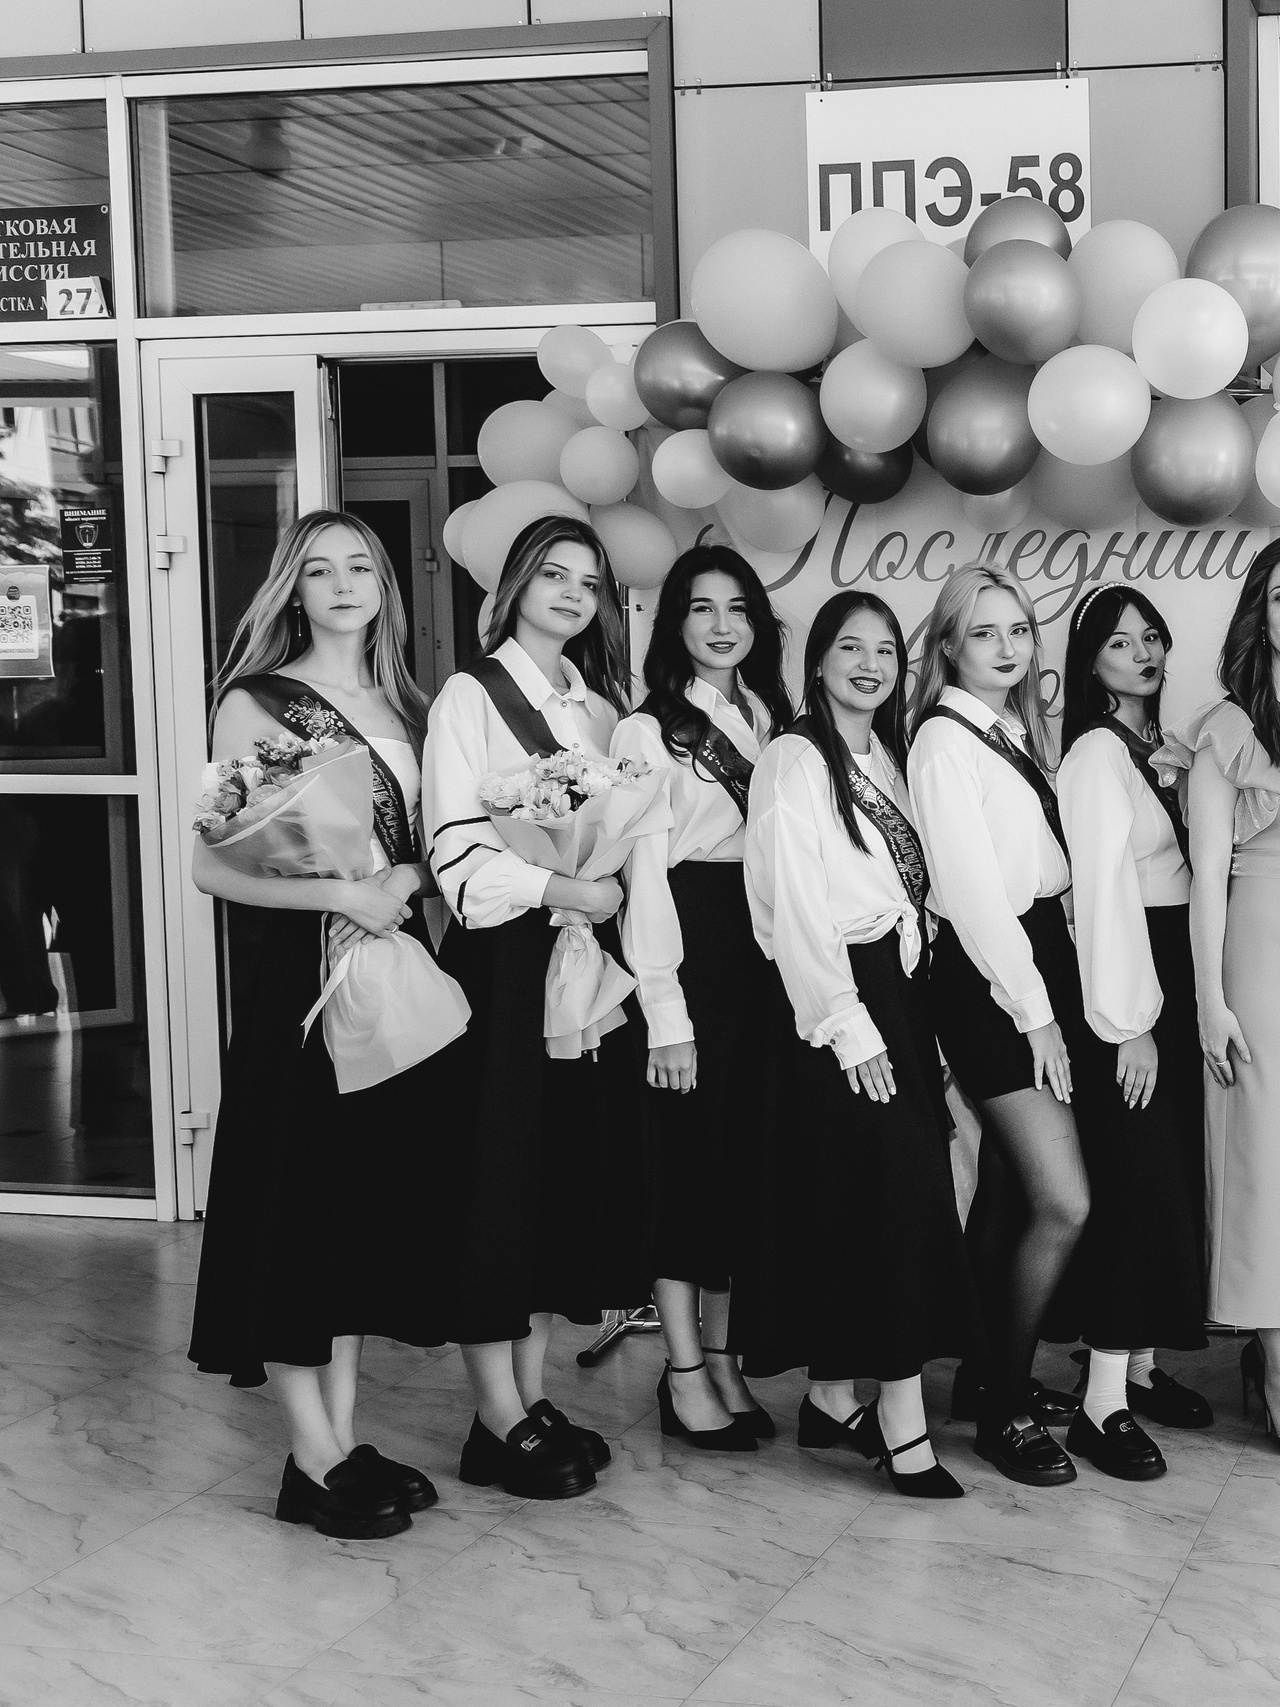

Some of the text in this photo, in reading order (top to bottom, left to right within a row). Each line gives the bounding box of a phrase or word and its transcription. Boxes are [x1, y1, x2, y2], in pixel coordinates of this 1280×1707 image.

[818, 152, 1087, 232] ППЭ-58
[0, 296, 35, 312] СТКА
[58, 287, 104, 316] 27
